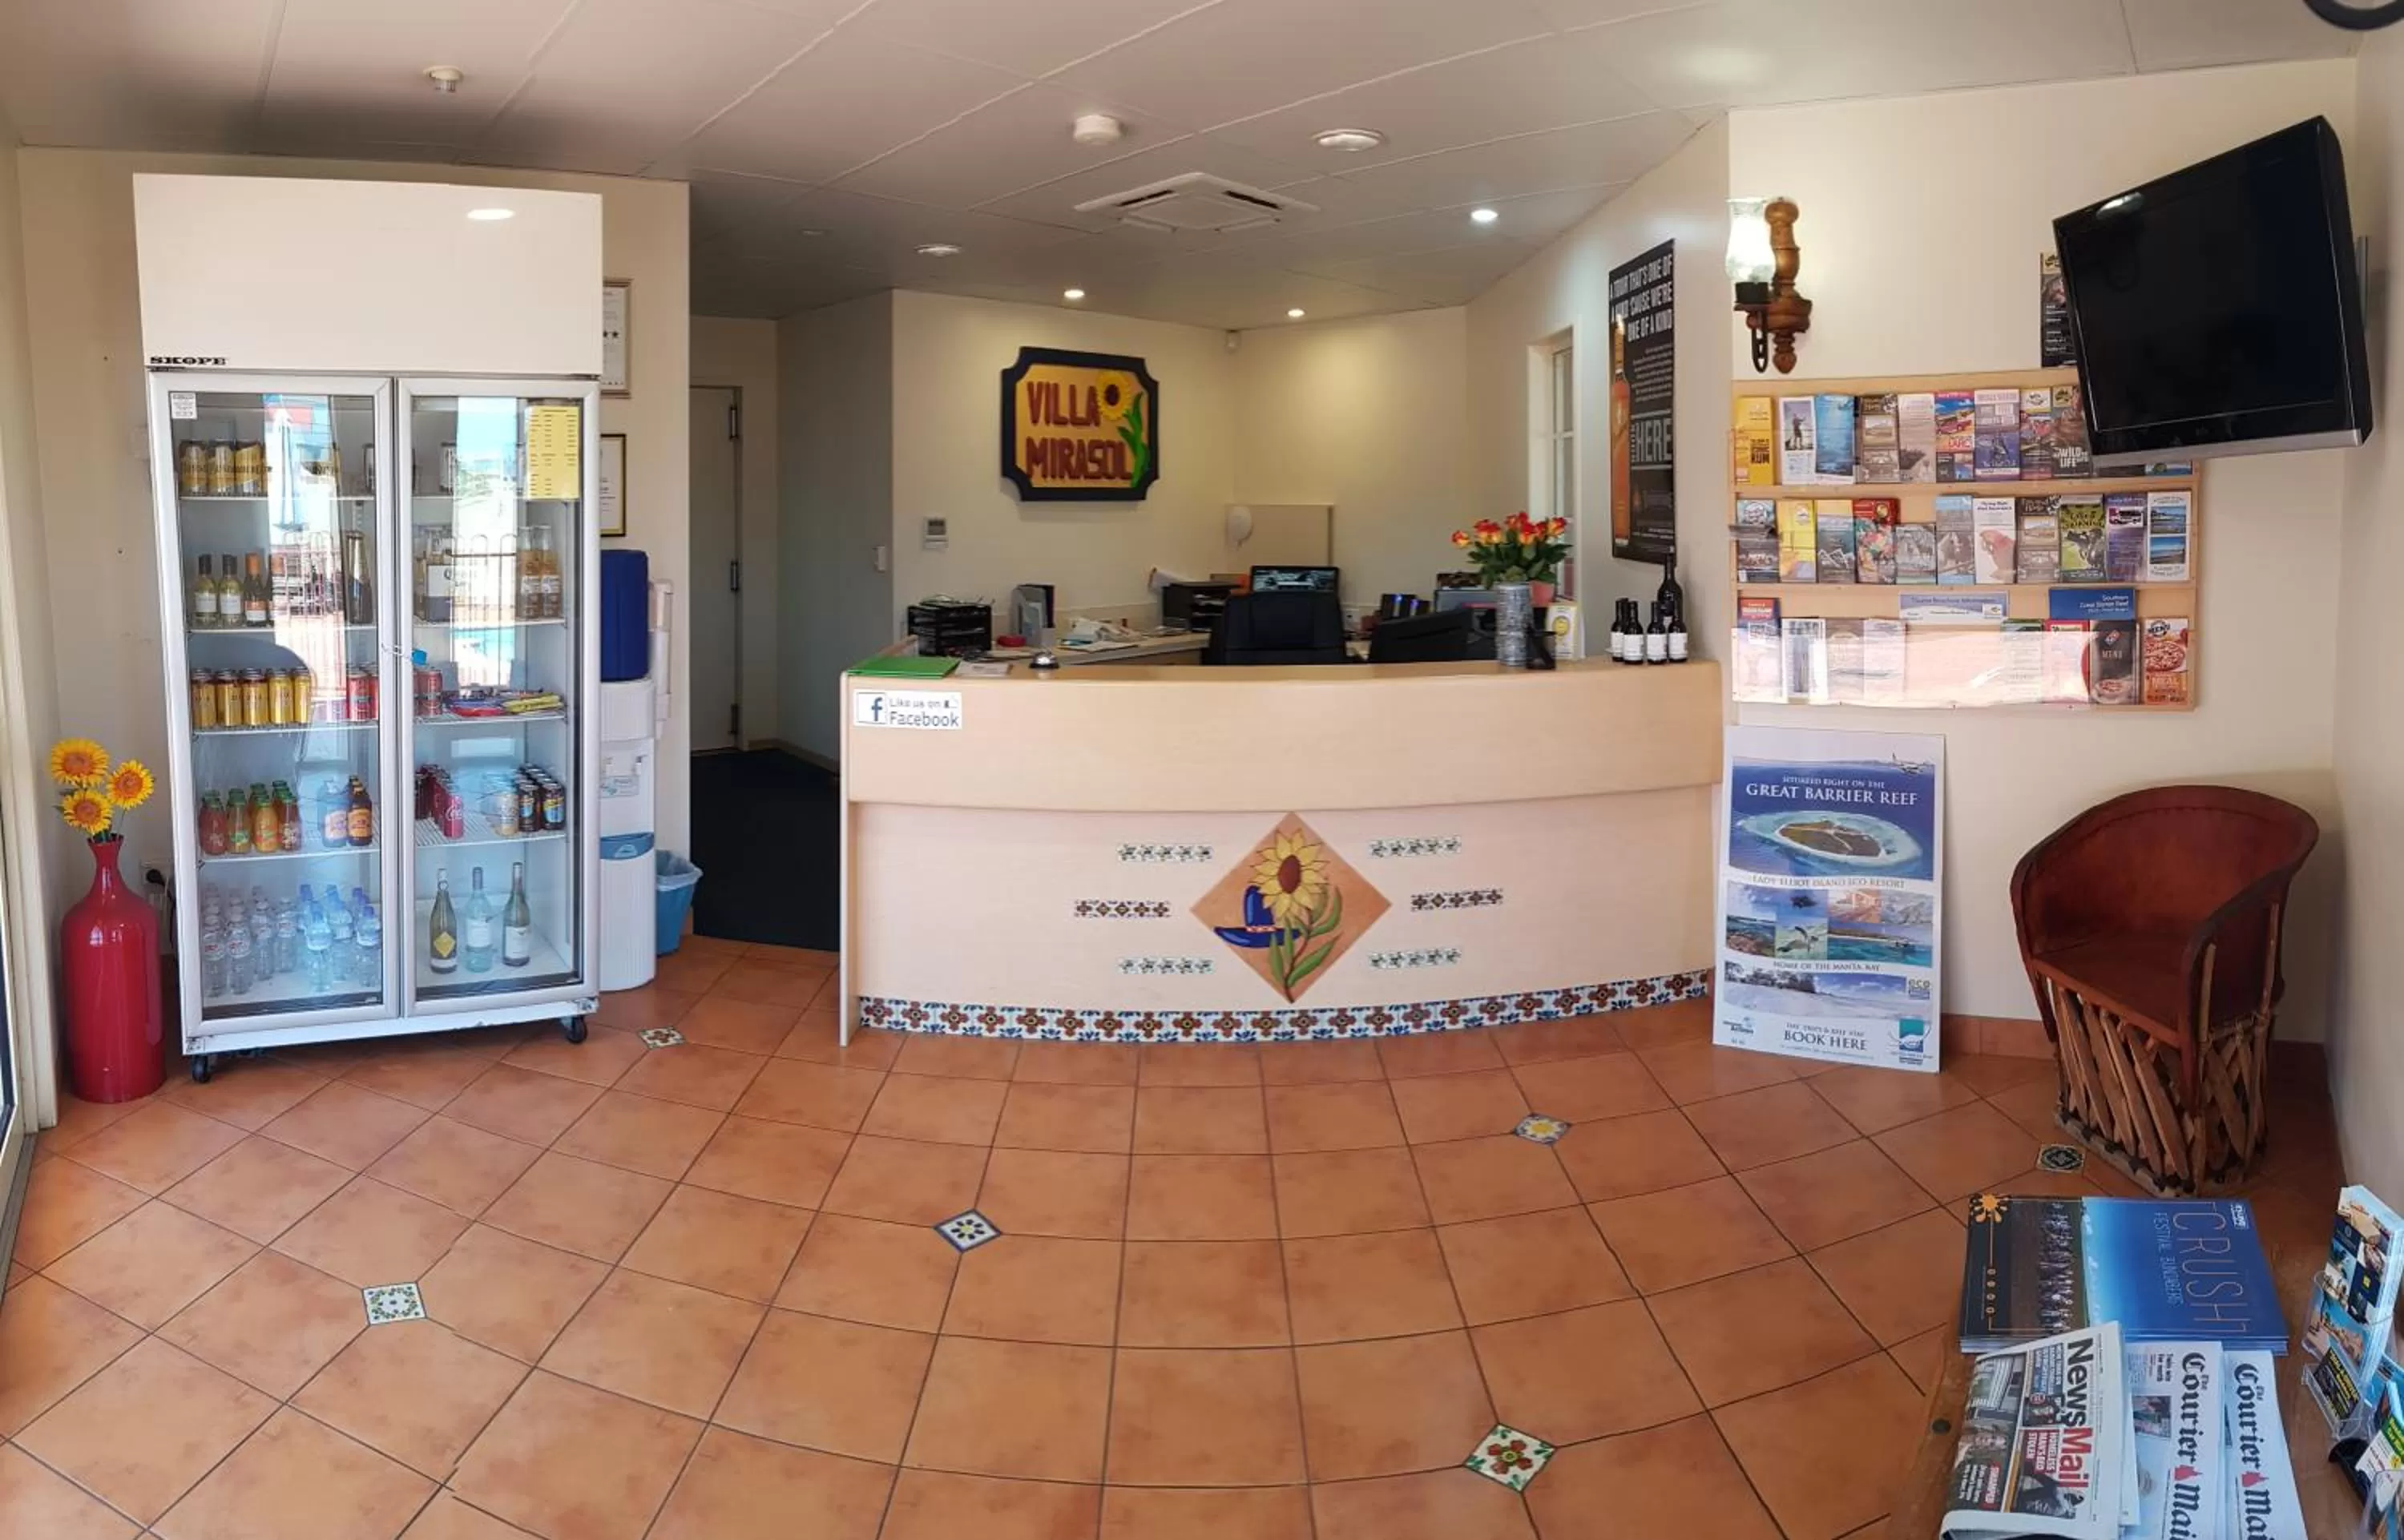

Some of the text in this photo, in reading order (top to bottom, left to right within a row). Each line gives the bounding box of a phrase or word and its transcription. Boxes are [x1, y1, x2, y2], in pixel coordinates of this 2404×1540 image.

[1648, 258, 1662, 282] ONE
[1663, 254, 1672, 276] OF
[1628, 320, 1640, 342] ONE
[1640, 316, 1650, 337] OF
[1655, 308, 1672, 333] KIND
[150, 356, 227, 365] SKOPE
[1027, 381, 1101, 427] VILLA
[1636, 417, 1672, 462] HERE
[1026, 435, 1133, 481] MIRASOL
[2059, 446, 2082, 458] WILD
[2060, 458, 2076, 468] LIFE
[2102, 649, 2123, 659] MENU
[889, 698, 941, 708] Like us on
[889, 711, 959, 727] Facebook
[1823, 777, 1849, 787] RIGHT
[1868, 781, 1886, 789] THE
[1746, 783, 1918, 806] GREAT BARRIER REEF
[1870, 880, 1906, 889] RESORT
[1815, 962, 1830, 970] THE
[1832, 963, 1861, 971] MANTA
[1908, 978, 1930, 989] eco
[1784, 1030, 1867, 1051] BOOK HERE
[2173, 1211, 2251, 1321] CRUSH
[2200, 1373, 2210, 1391] The
[2256, 1385, 2265, 1401] The
[2176, 1352, 2206, 1463] Courier
[2027, 1432, 2038, 1460] STOLEN
[2047, 1431, 2059, 1472] HOMELESS
[2234, 1363, 2275, 1540] Courier Mai
